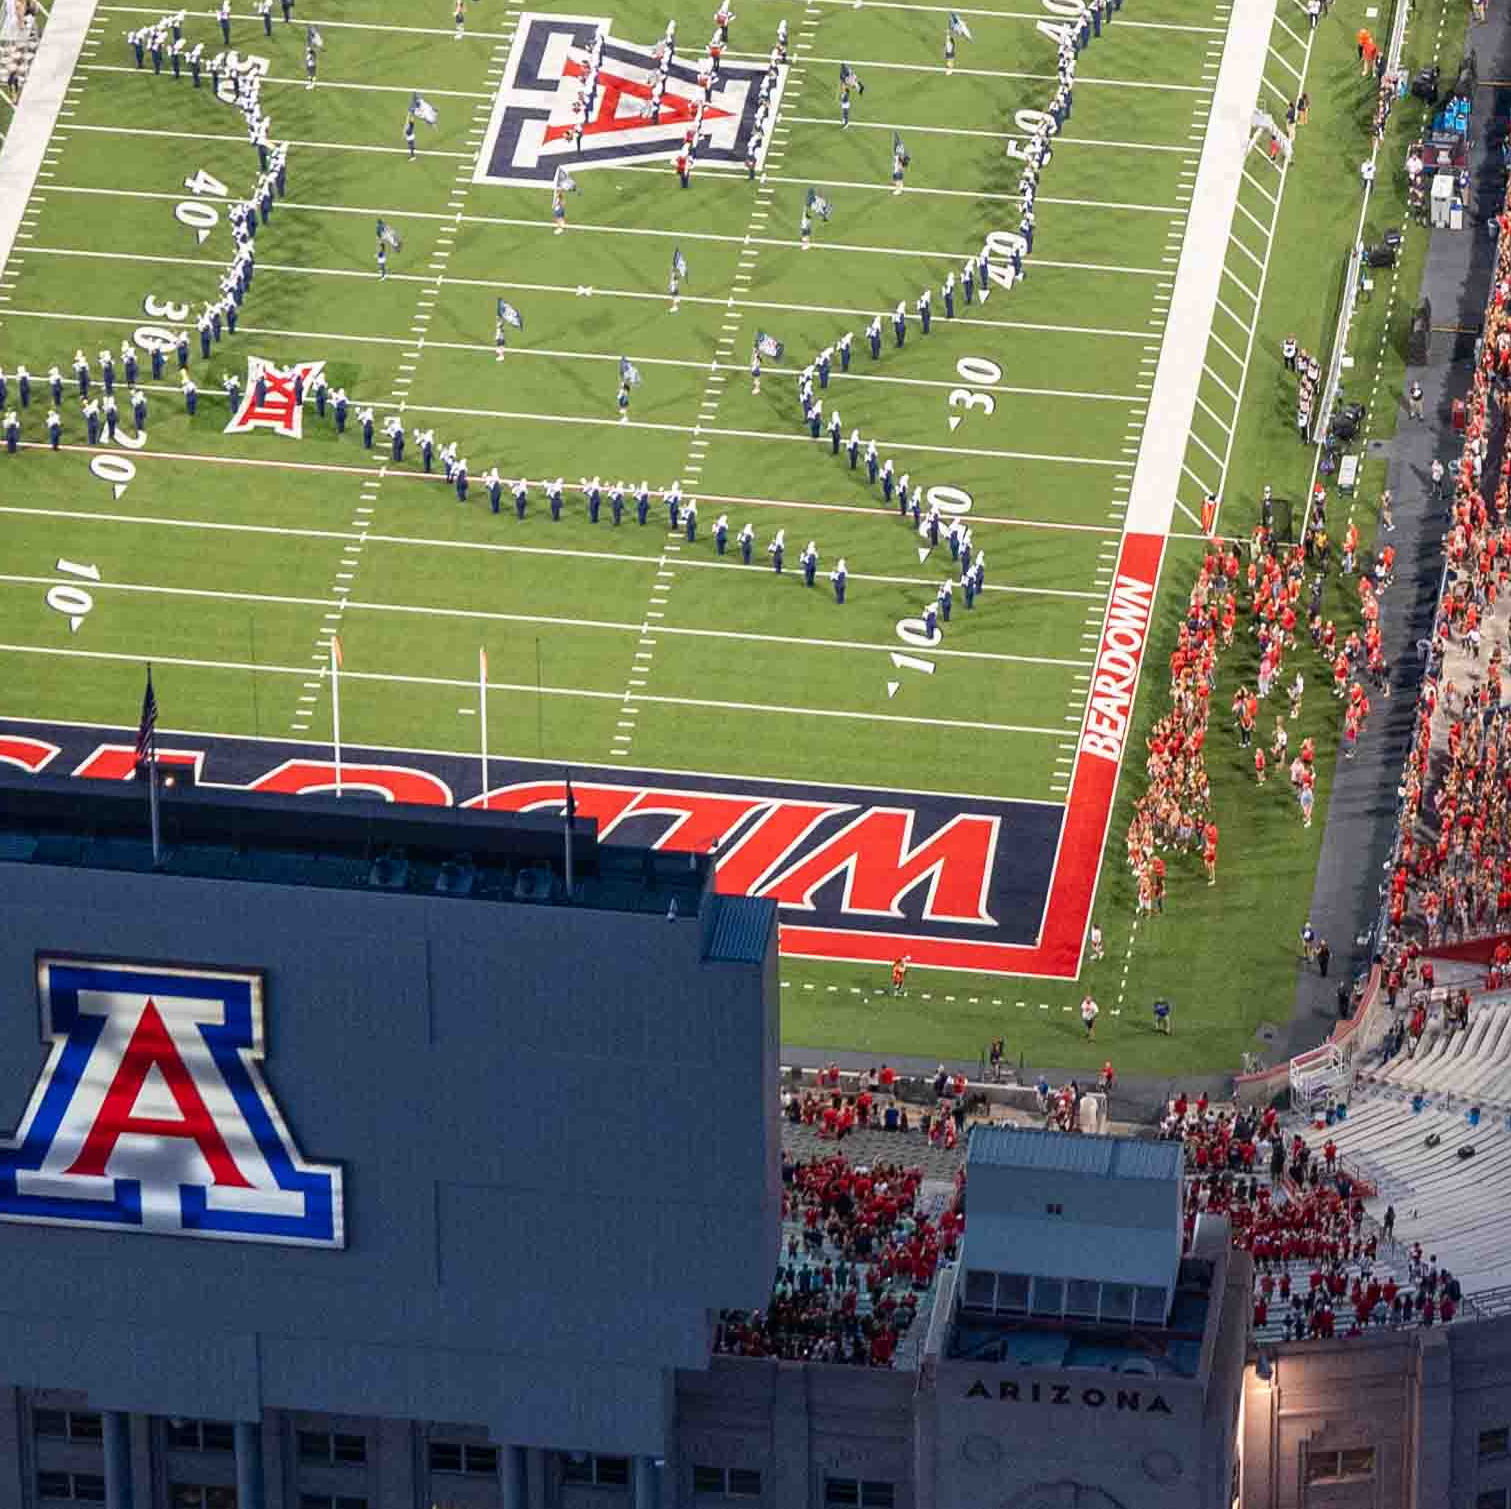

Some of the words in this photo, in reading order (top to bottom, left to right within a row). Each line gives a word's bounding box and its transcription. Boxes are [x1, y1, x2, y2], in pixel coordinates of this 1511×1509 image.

[175, 169, 229, 228] 40
[133, 295, 188, 353] 30
[949, 356, 1002, 416] 30
[47, 558, 101, 615] 10
[890, 617, 943, 675] 10
[964, 1379, 1173, 1414] ARIZONA
